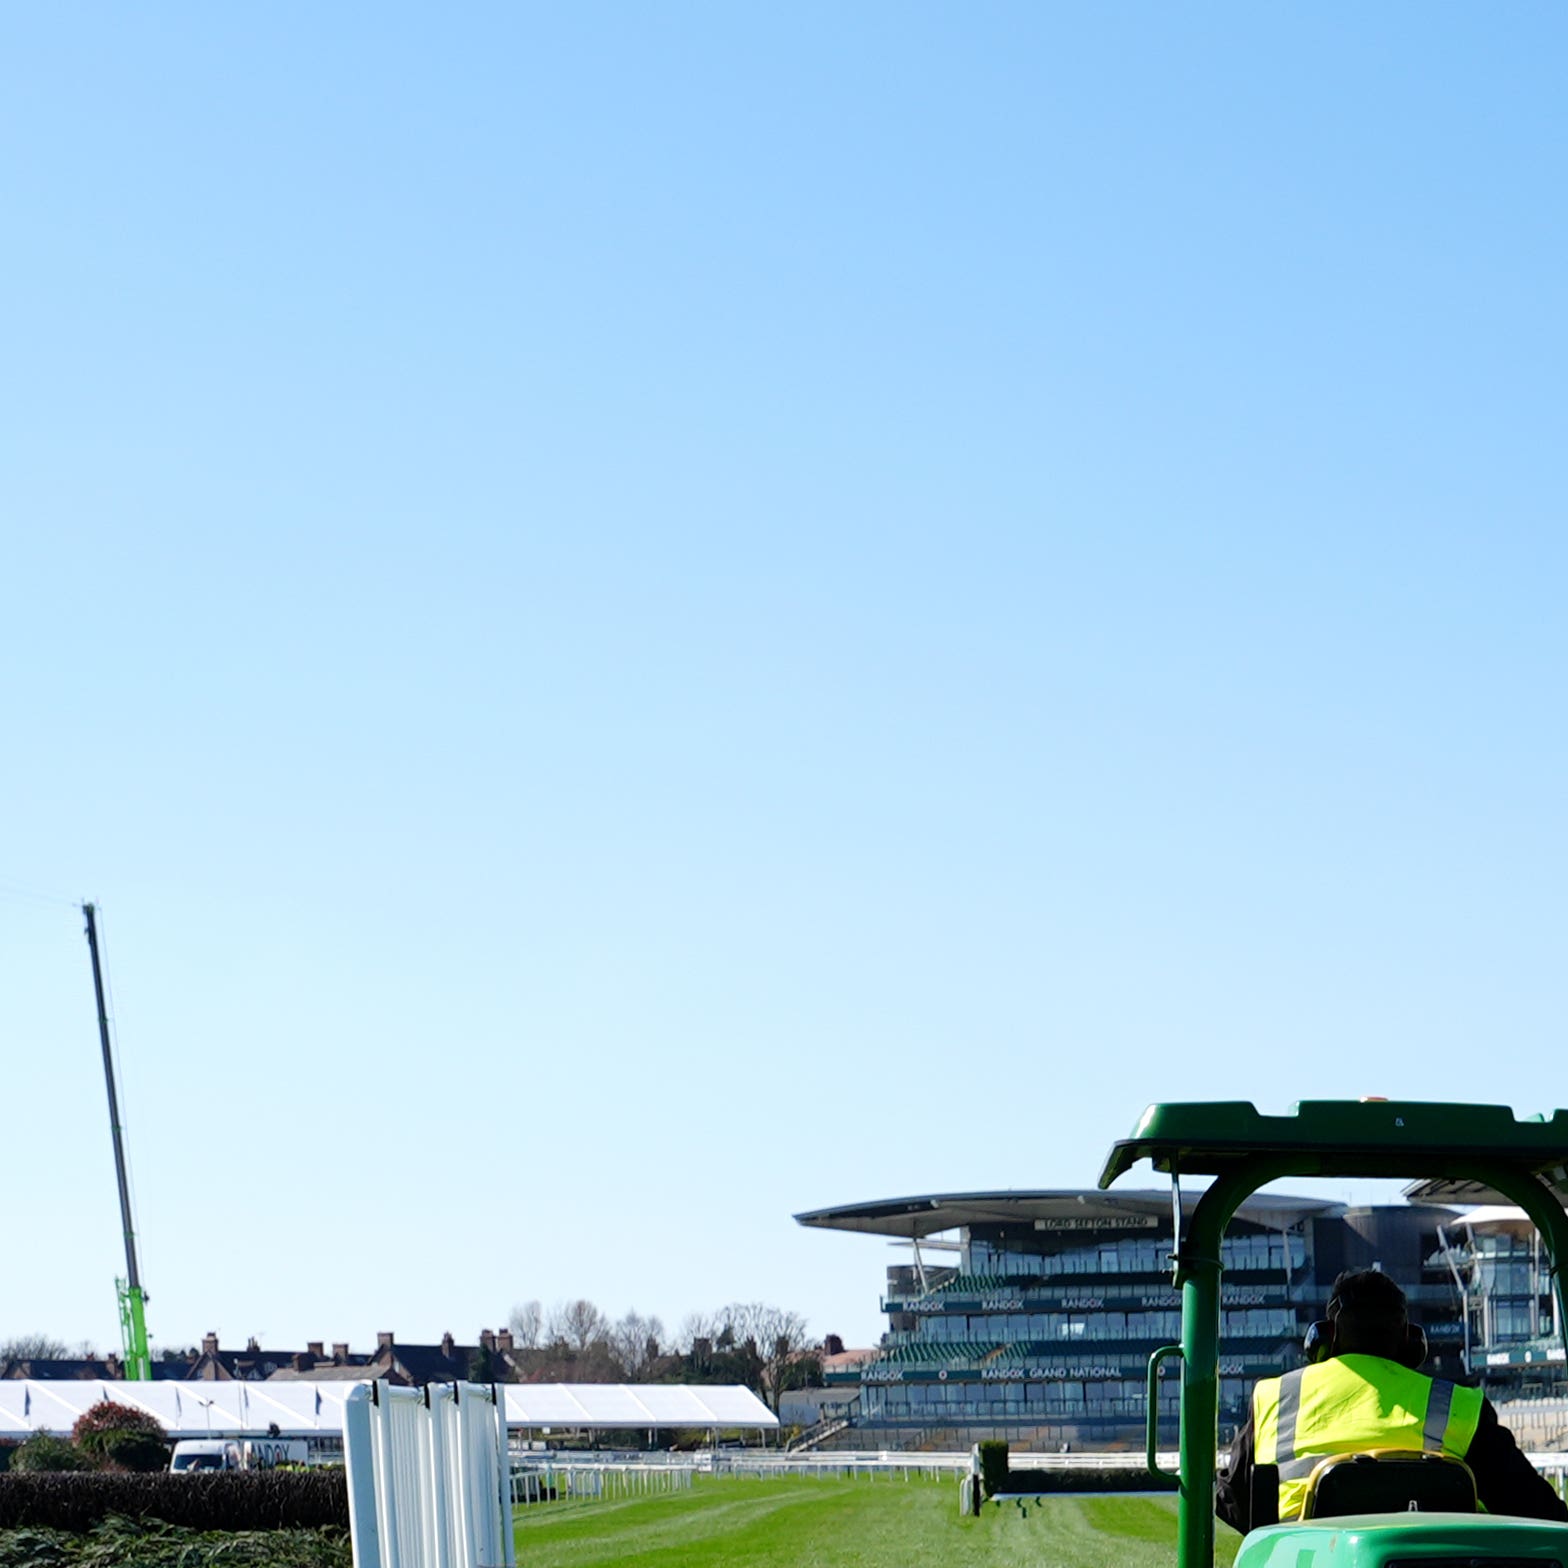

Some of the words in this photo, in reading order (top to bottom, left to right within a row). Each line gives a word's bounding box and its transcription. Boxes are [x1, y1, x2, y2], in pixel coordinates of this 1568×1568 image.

[902, 1301, 945, 1312] RANDOX
[982, 1300, 1024, 1311] RANDOX
[1061, 1298, 1104, 1309] RANDOX
[861, 1371, 904, 1382] RANDOX
[982, 1368, 1025, 1379] RANDOX
[1029, 1368, 1066, 1379] GRAND
[1070, 1366, 1121, 1378] NATIONAL
